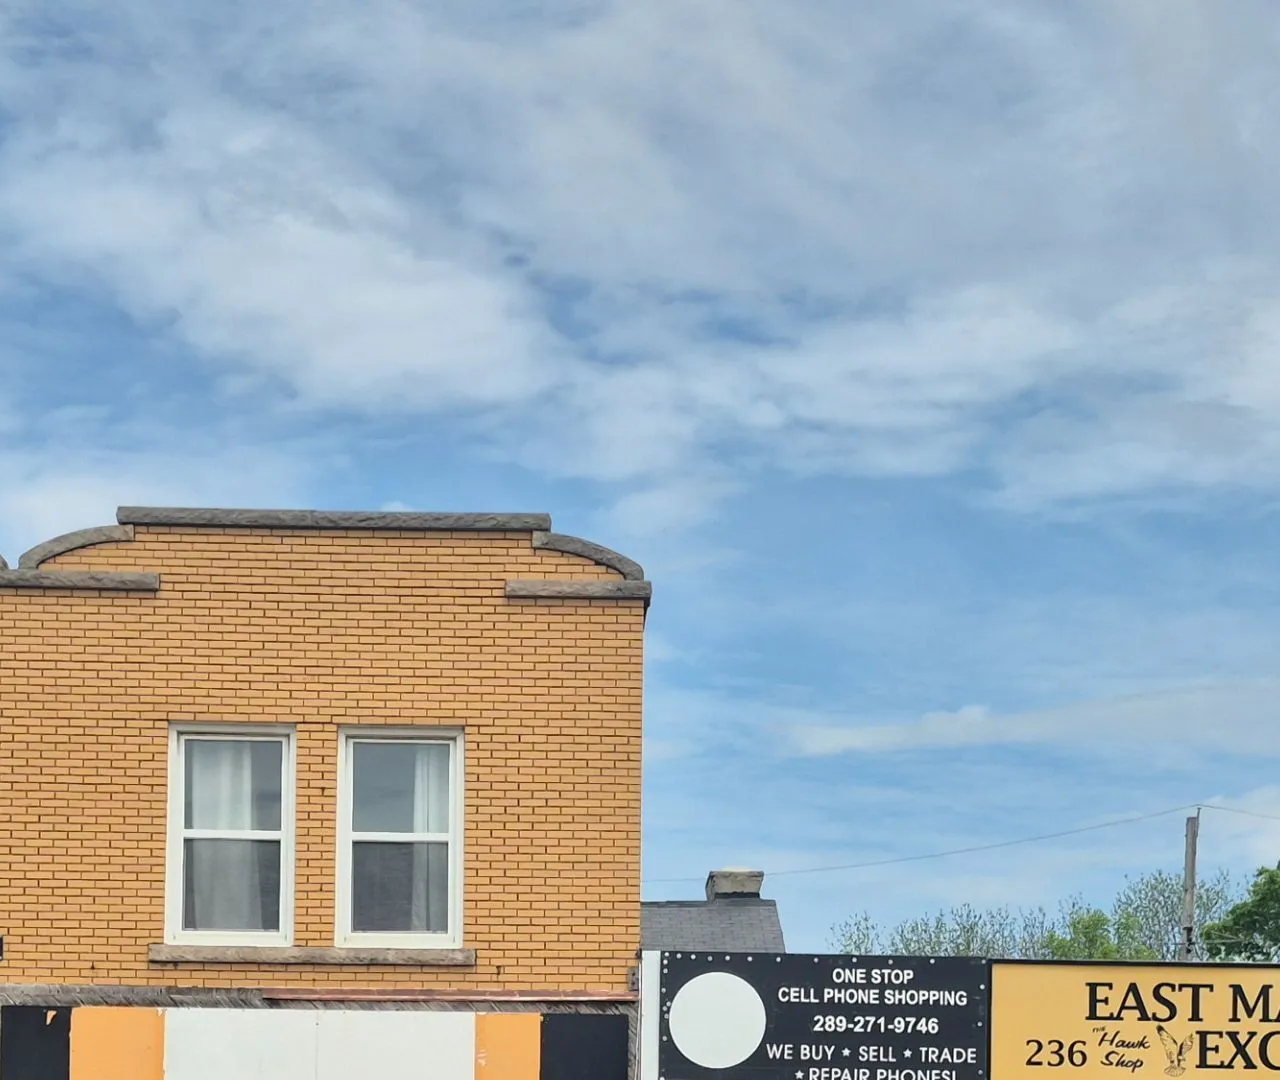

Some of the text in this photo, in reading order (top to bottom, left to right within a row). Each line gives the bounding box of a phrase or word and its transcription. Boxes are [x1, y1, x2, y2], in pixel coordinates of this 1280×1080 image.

[832, 968, 913, 984] ONE STOP
[778, 987, 967, 1006] CELL PHONE SHOPPING
[1085, 982, 1213, 1022] EAST
[813, 1016, 939, 1034] 289-271-9746
[1098, 1030, 1151, 1049] Hawk
[766, 1044, 977, 1064] WE BUY SELL TRADE
[1025, 1039, 1087, 1067] 236
[1100, 1050, 1144, 1073] Shop
